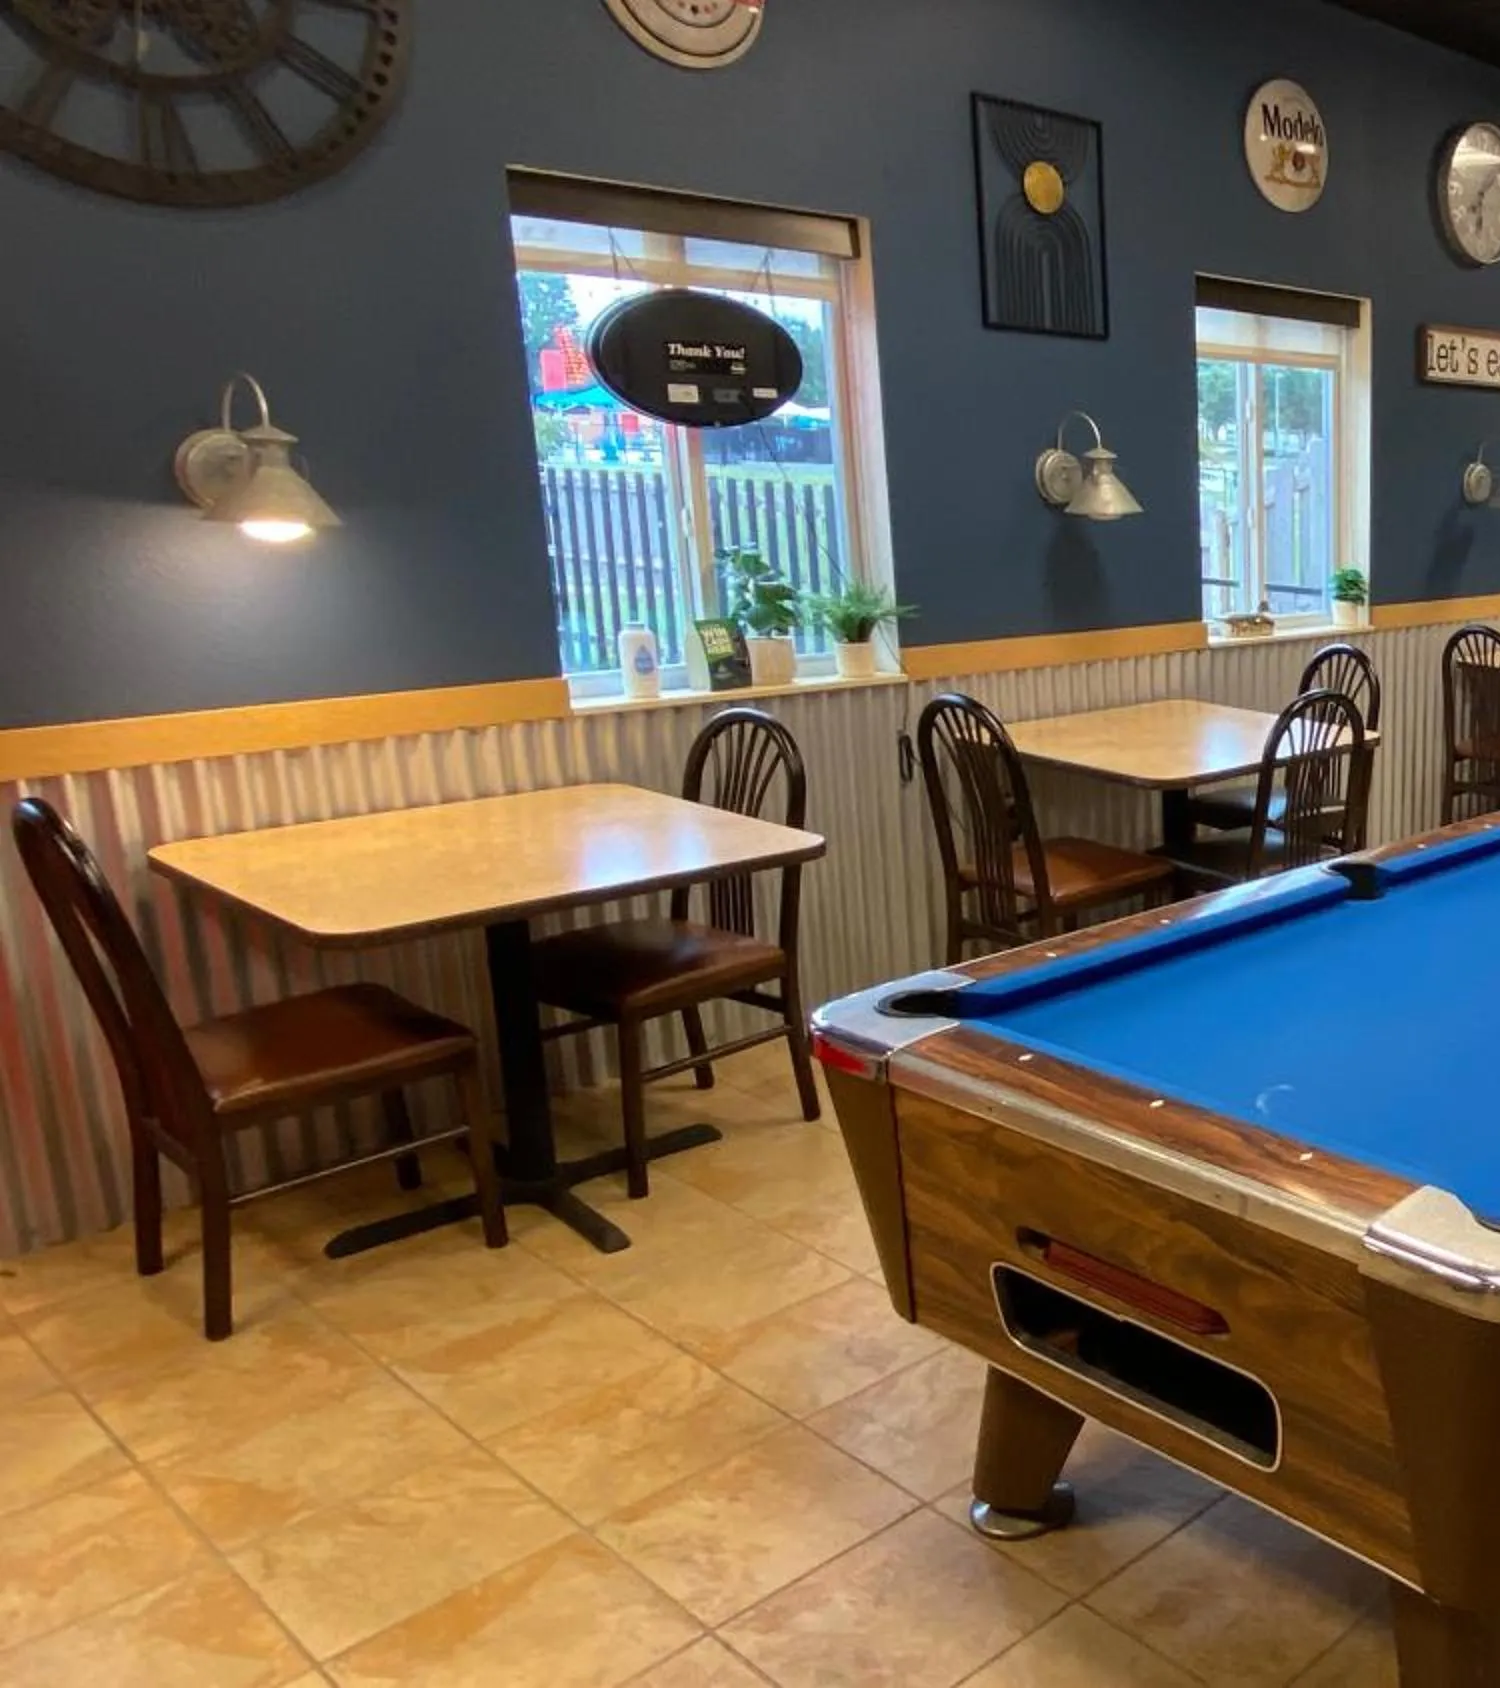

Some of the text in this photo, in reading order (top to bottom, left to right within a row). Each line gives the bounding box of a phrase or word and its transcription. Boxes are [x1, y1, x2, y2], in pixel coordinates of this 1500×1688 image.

[667, 343, 745, 359] Thank You!
[1426, 333, 1479, 376] let's
